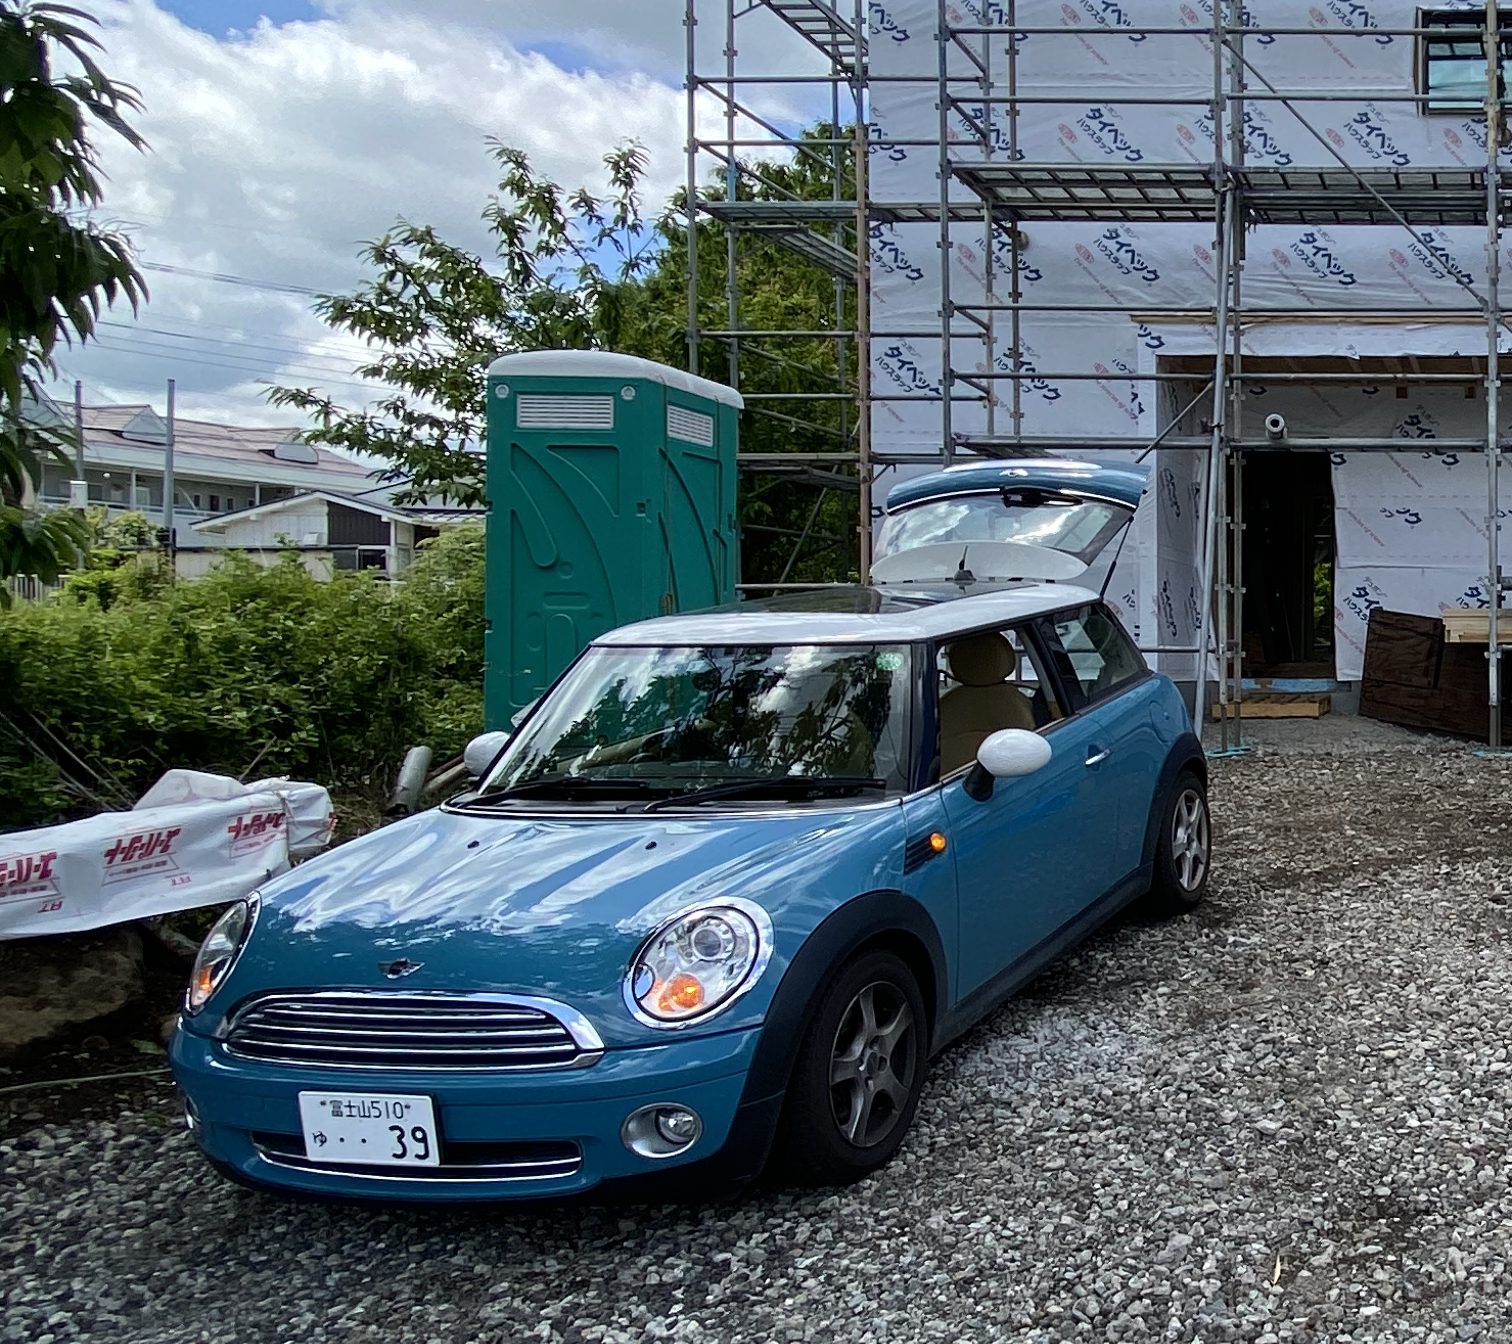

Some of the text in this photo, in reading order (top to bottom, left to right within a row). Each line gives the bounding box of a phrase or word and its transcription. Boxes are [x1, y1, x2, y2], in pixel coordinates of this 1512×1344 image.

[1075, 117, 1116, 156] ハウスラップ
[1085, 106, 1145, 163] タイベック
[1342, 121, 1383, 161] ハウスラップ
[1352, 111, 1412, 167] タイベック
[1092, 237, 1132, 276] ハウスラップ
[1102, 227, 1161, 283] タイベック
[1289, 241, 1329, 280] ハウスラップ
[1298, 231, 1358, 287] タイベック
[1407, 241, 1447, 281] ハウスラップ
[874, 355, 914, 394] ハウスラップ
[388, 1124, 430, 1161] 39
